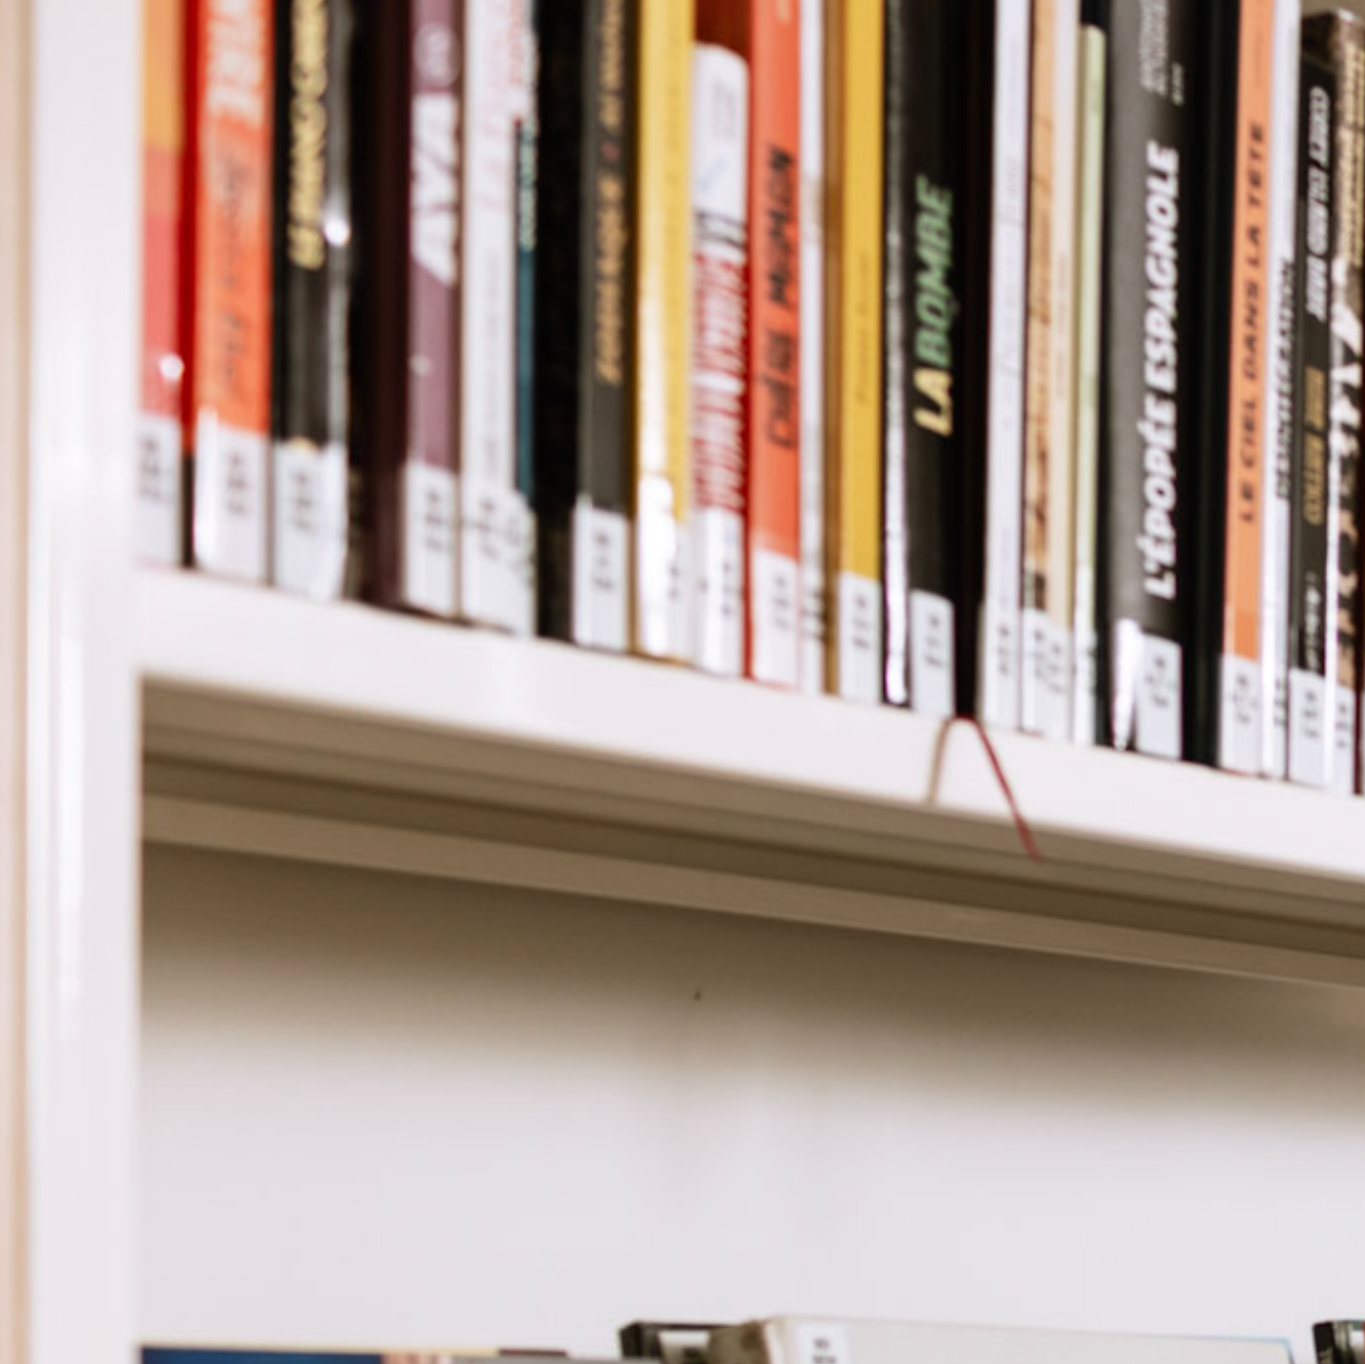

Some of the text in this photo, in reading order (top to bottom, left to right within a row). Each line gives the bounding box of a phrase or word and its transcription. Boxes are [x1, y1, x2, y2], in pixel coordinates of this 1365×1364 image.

[914, 174, 955, 436] LA BOMBE
[1145, 141, 1179, 392] ESPAGNOLE
[1136, 395, 1176, 599] L'ÉPOPÉE
